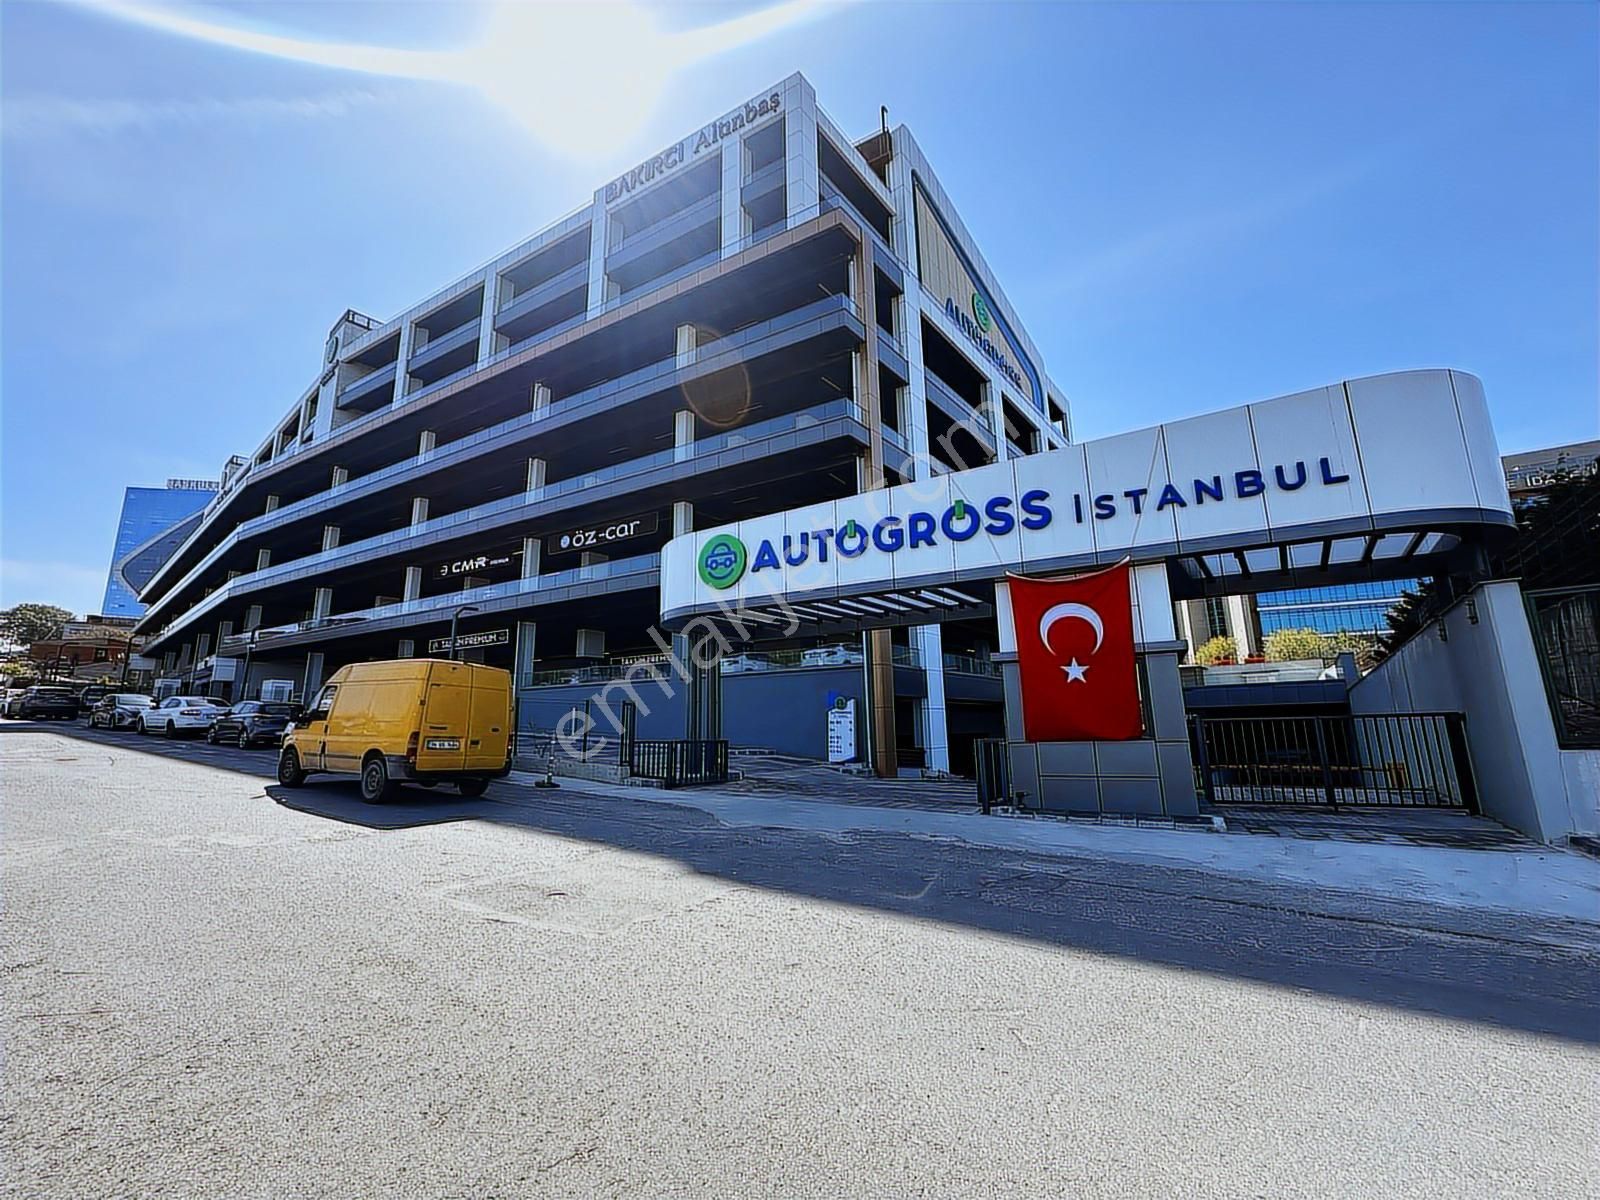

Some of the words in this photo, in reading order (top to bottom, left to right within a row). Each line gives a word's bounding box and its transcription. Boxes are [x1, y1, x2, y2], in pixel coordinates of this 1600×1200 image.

[605, 141, 684, 205] BAKIRCI
[751, 489, 1053, 573] AUTOGROSS
[1073, 457, 1350, 524] ISTANBUL
[452, 556, 486, 573] CMR
